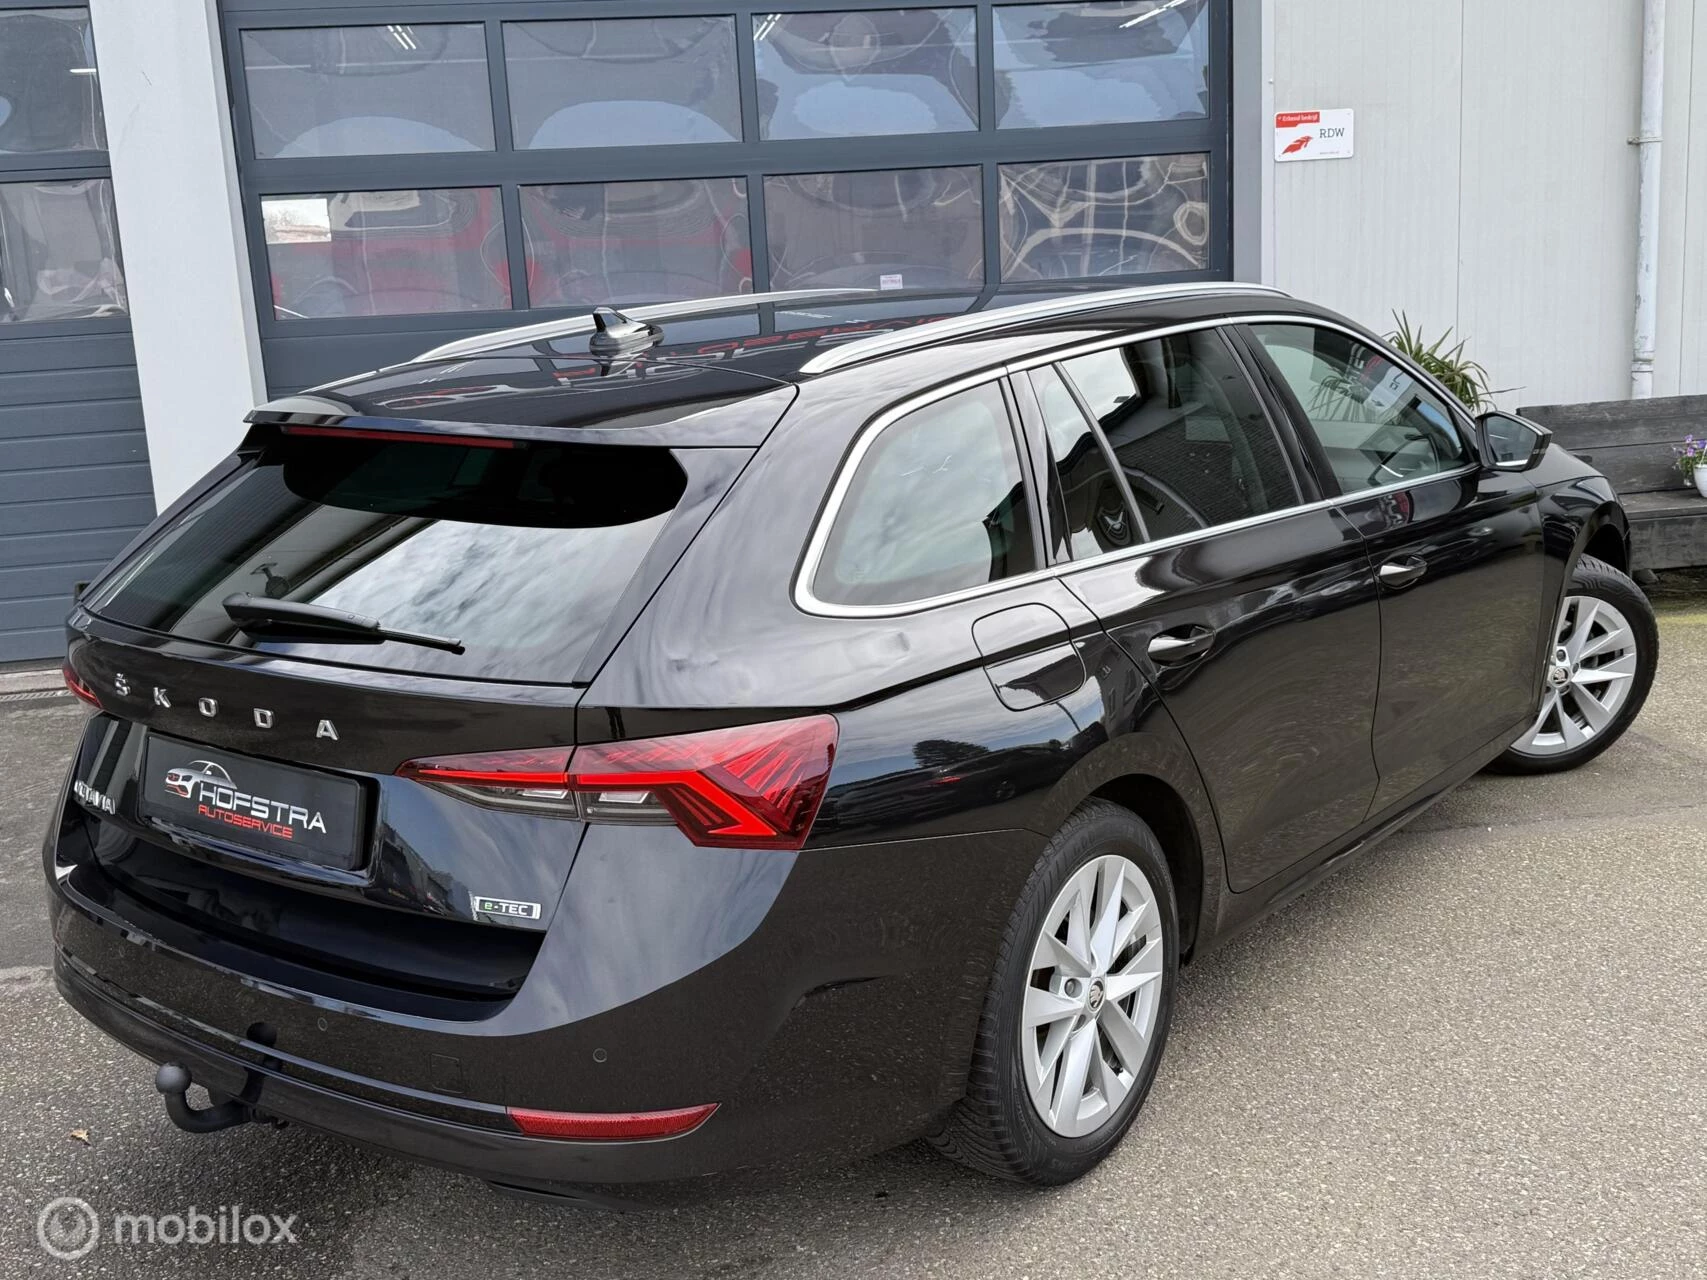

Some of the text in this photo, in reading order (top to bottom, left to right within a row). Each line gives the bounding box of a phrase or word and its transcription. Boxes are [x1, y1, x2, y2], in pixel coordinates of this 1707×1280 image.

[1319, 127, 1344, 138] RDW
[198, 804, 294, 839] AUTOSERVICE
[199, 782, 327, 834] HOFSTRA
